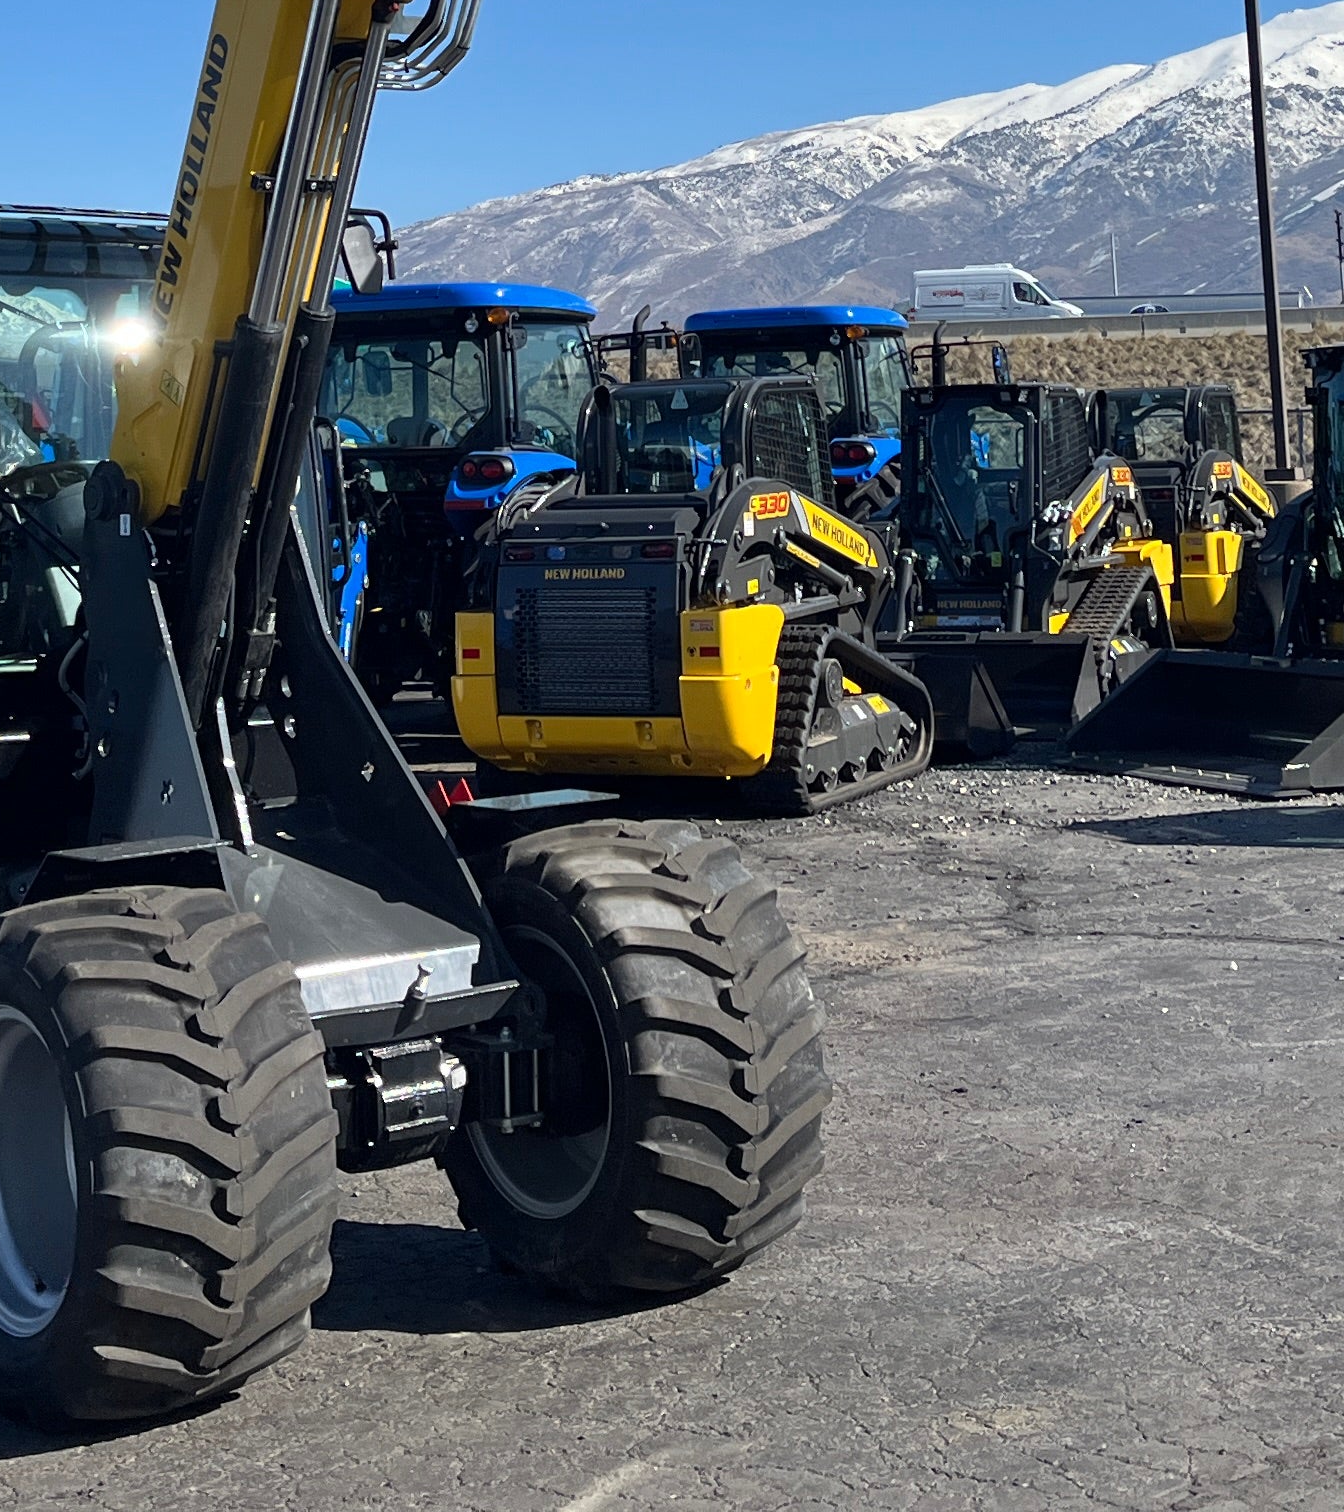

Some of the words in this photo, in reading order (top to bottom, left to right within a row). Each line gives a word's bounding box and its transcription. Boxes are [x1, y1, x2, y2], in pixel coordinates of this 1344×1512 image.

[152, 33, 228, 239] HOLLAND
[750, 494, 788, 516] C330
[812, 514, 830, 534] NEW
[831, 525, 865, 557] HOLLAND
[544, 569, 570, 580] NEW
[572, 568, 625, 580] HOLLAND
[937, 600, 958, 608] NEW
[959, 600, 1002, 609] HOLLAND
